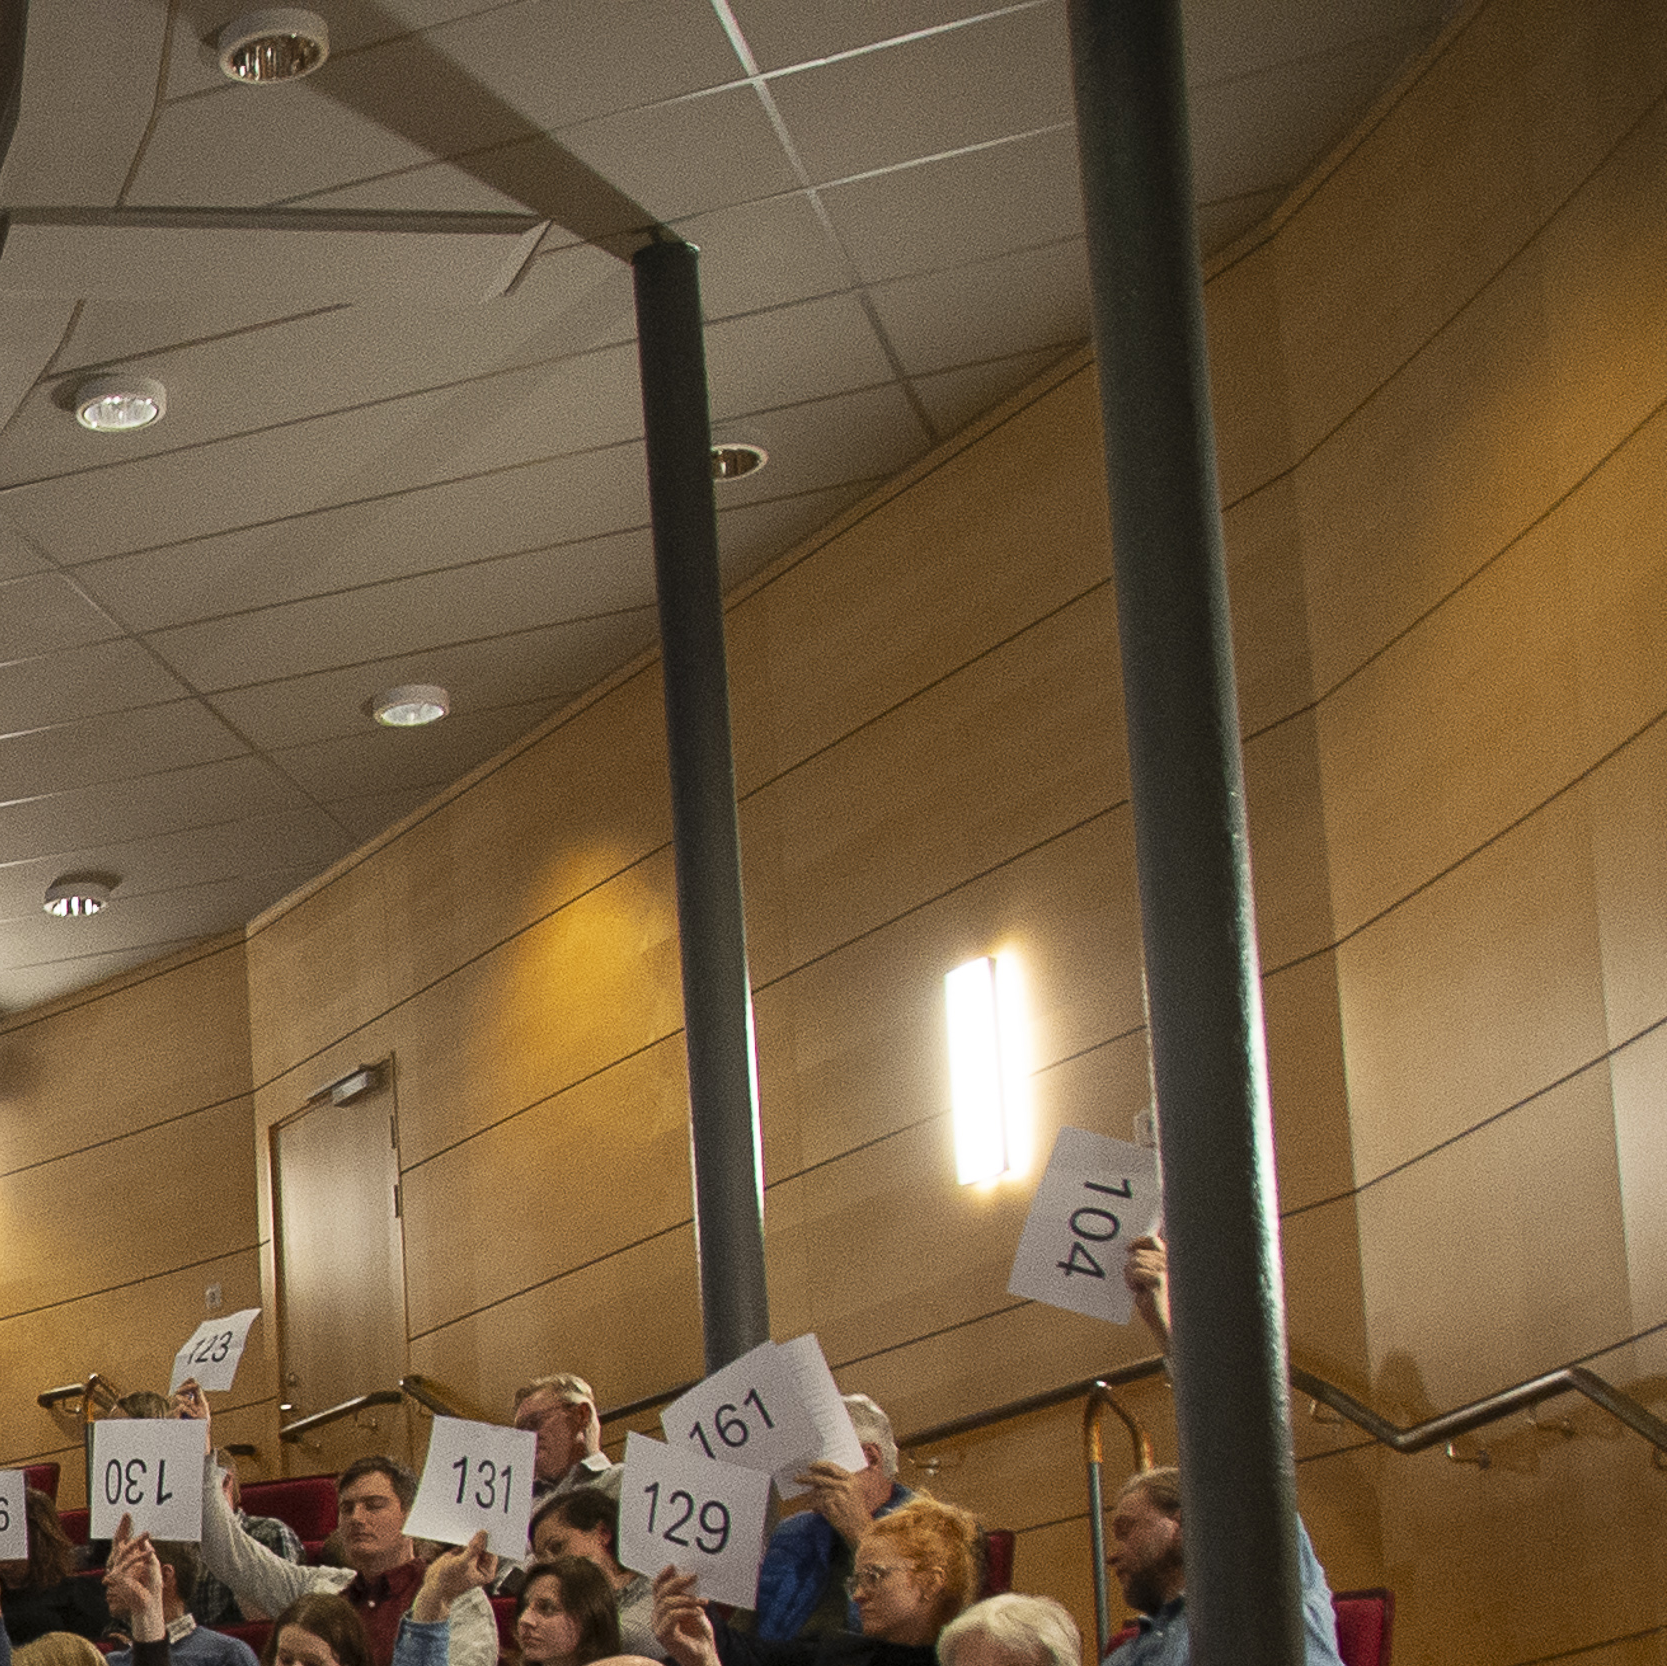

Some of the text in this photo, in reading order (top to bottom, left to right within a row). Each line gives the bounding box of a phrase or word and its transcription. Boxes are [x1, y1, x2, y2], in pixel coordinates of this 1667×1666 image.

[1057, 1177, 1133, 1281] 104
[187, 1330, 234, 1365] 123
[688, 1387, 777, 1461] 161
[104, 1458, 173, 1506] 130
[452, 1455, 513, 1514] 131
[643, 1480, 732, 1555] 129
